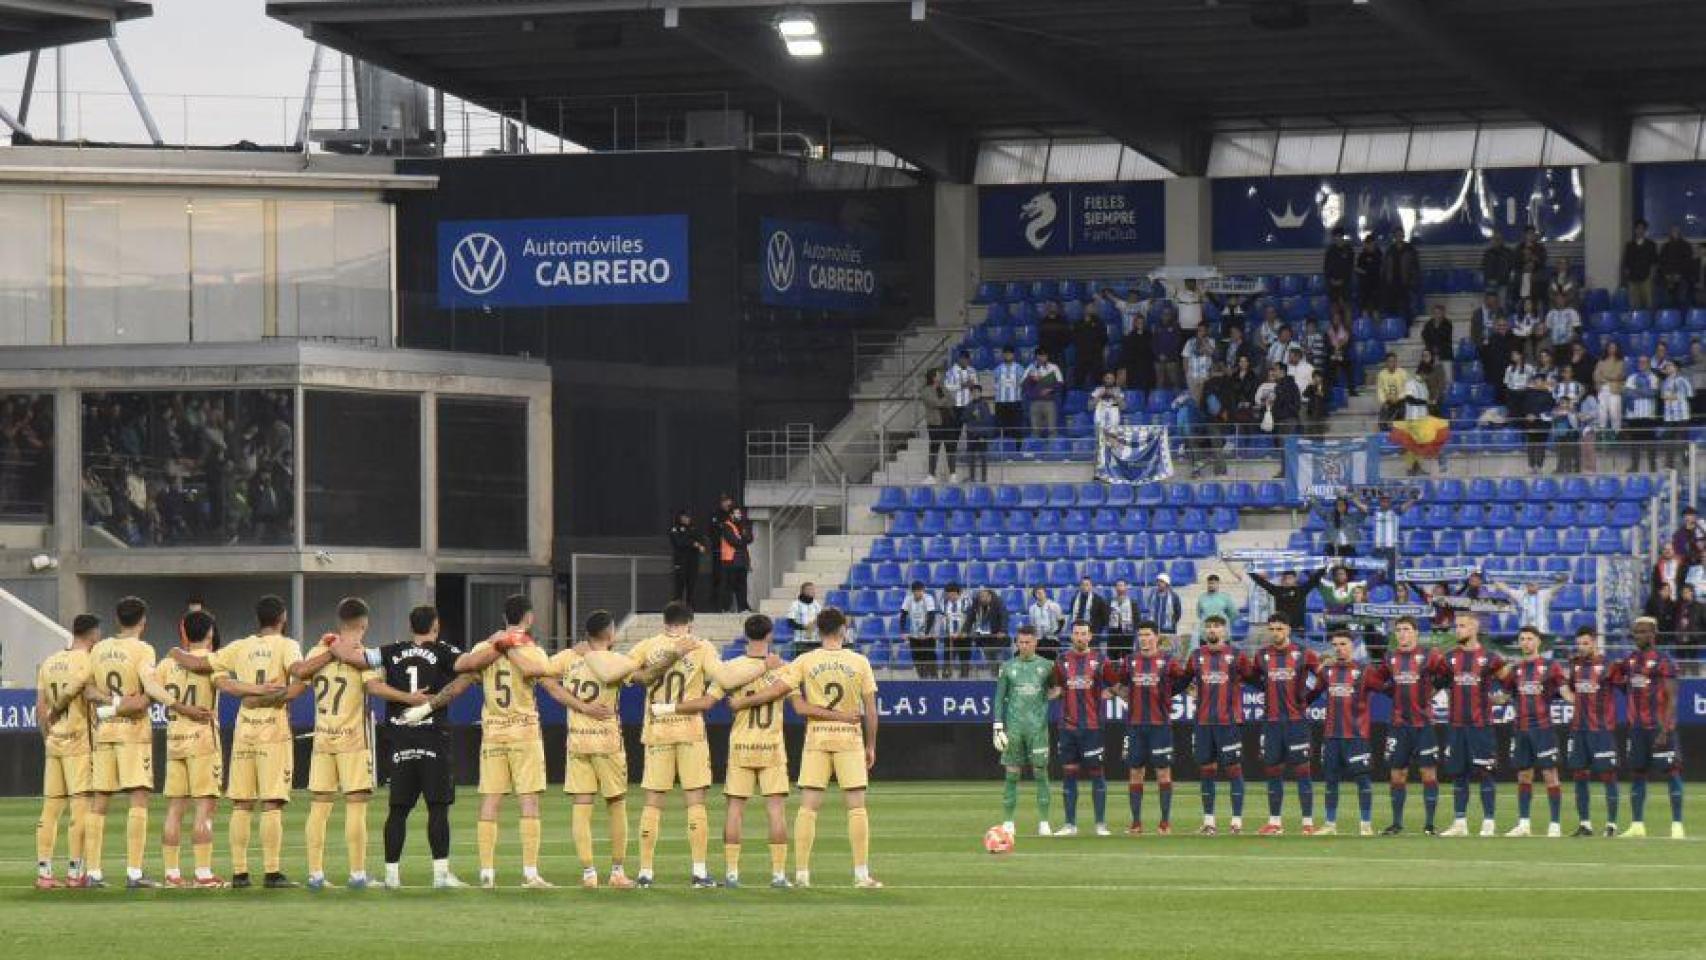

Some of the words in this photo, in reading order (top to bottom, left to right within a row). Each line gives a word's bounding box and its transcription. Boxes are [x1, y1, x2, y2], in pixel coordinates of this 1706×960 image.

[1084, 211, 1136, 225] SIEMPRE
[523, 236, 643, 256] Automóviles
[535, 258, 670, 287] CABRERO
[809, 264, 875, 293] CABRERO
[406, 665, 418, 694] 1
[494, 670, 511, 708] 5
[313, 675, 347, 716] 27
[824, 683, 844, 711] 2
